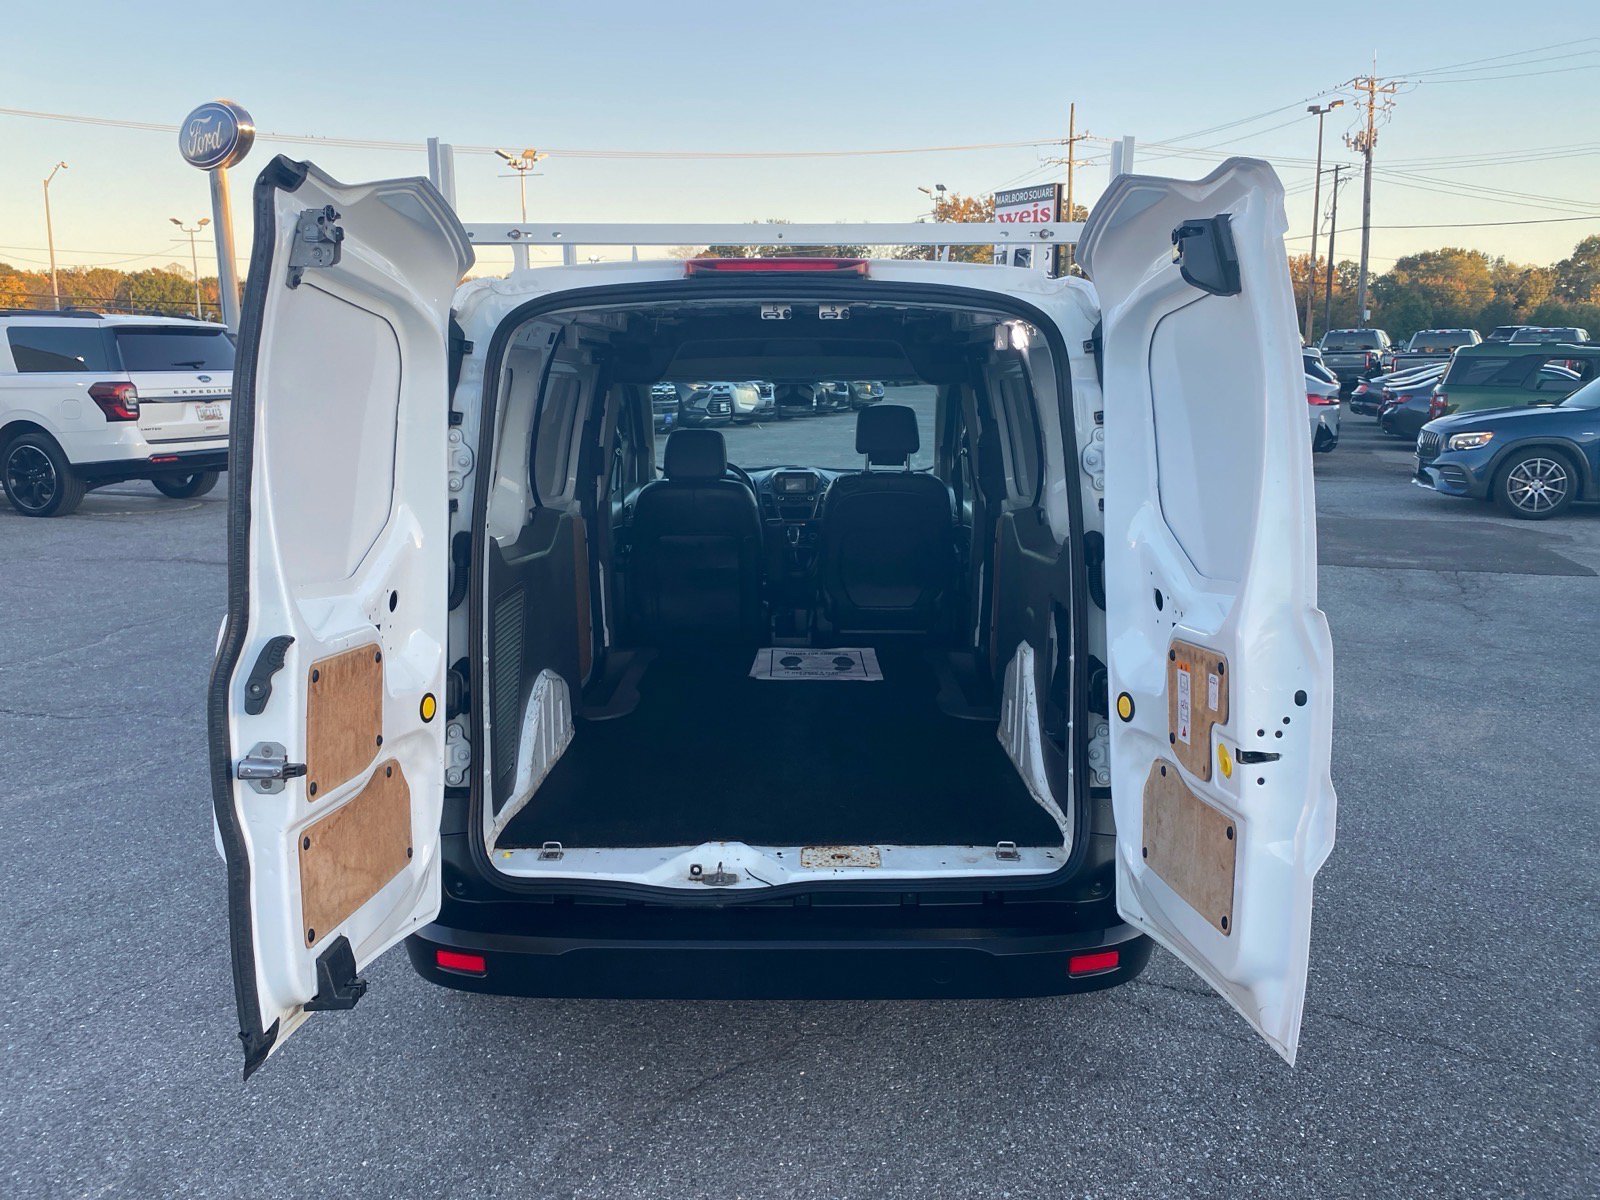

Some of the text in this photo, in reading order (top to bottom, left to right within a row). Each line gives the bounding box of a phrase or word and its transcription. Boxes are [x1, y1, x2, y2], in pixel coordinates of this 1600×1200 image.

[188, 115, 223, 157] Ford
[996, 186, 1054, 204] MARLBORO SQUARE
[998, 202, 1051, 223] weis
